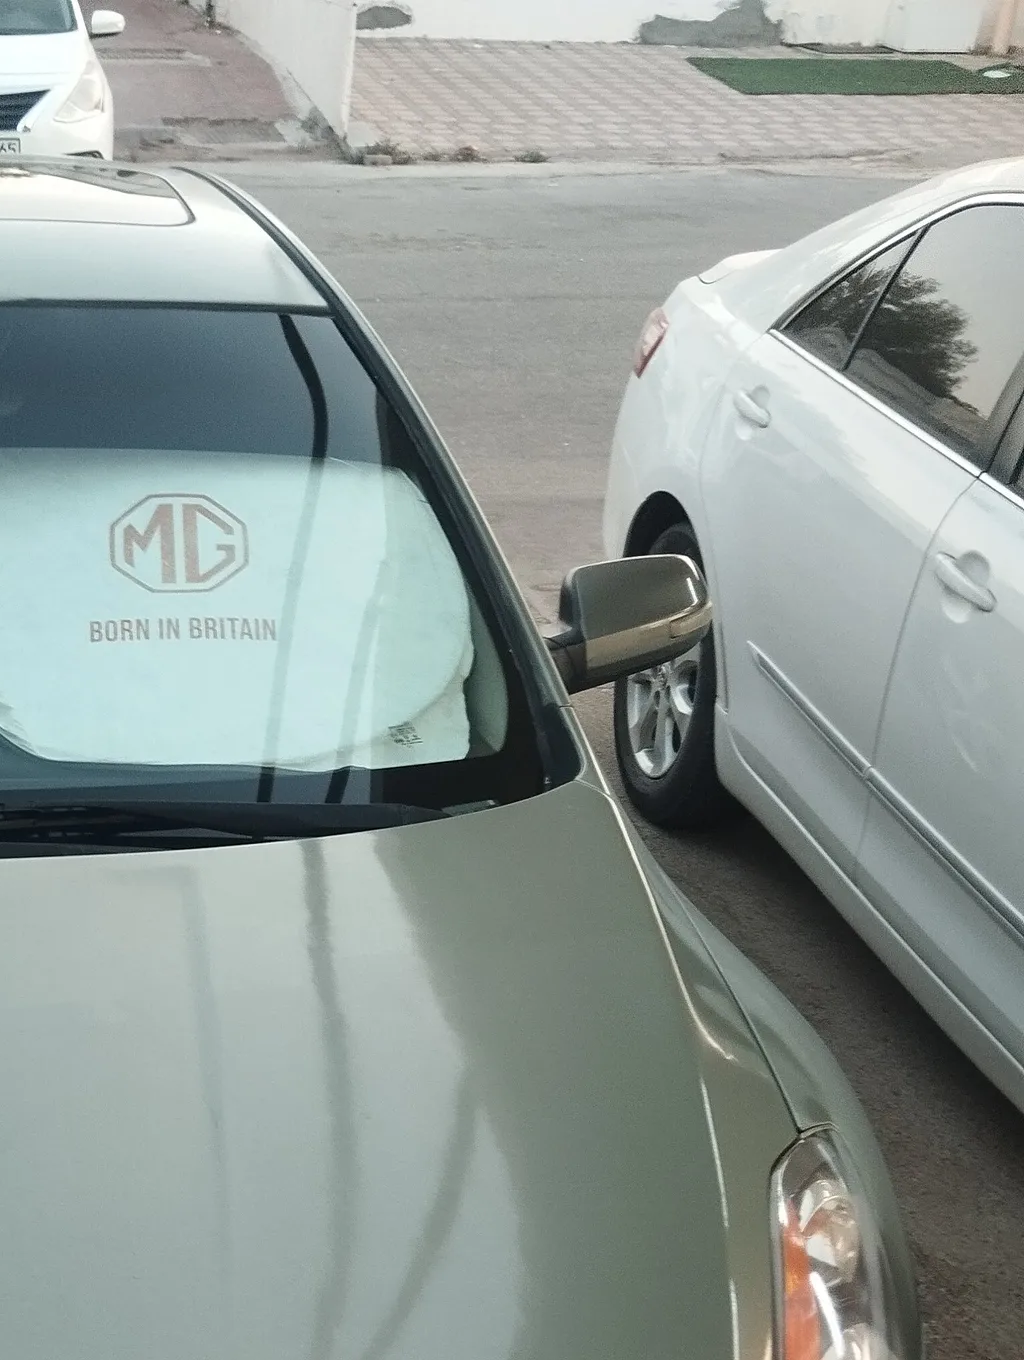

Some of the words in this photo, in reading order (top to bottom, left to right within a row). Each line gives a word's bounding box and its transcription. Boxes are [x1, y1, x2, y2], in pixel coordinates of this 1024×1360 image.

[122, 503, 237, 585] MG
[89, 618, 150, 643] BORN
[158, 617, 180, 640] IN
[188, 617, 277, 642] BRITAIN
